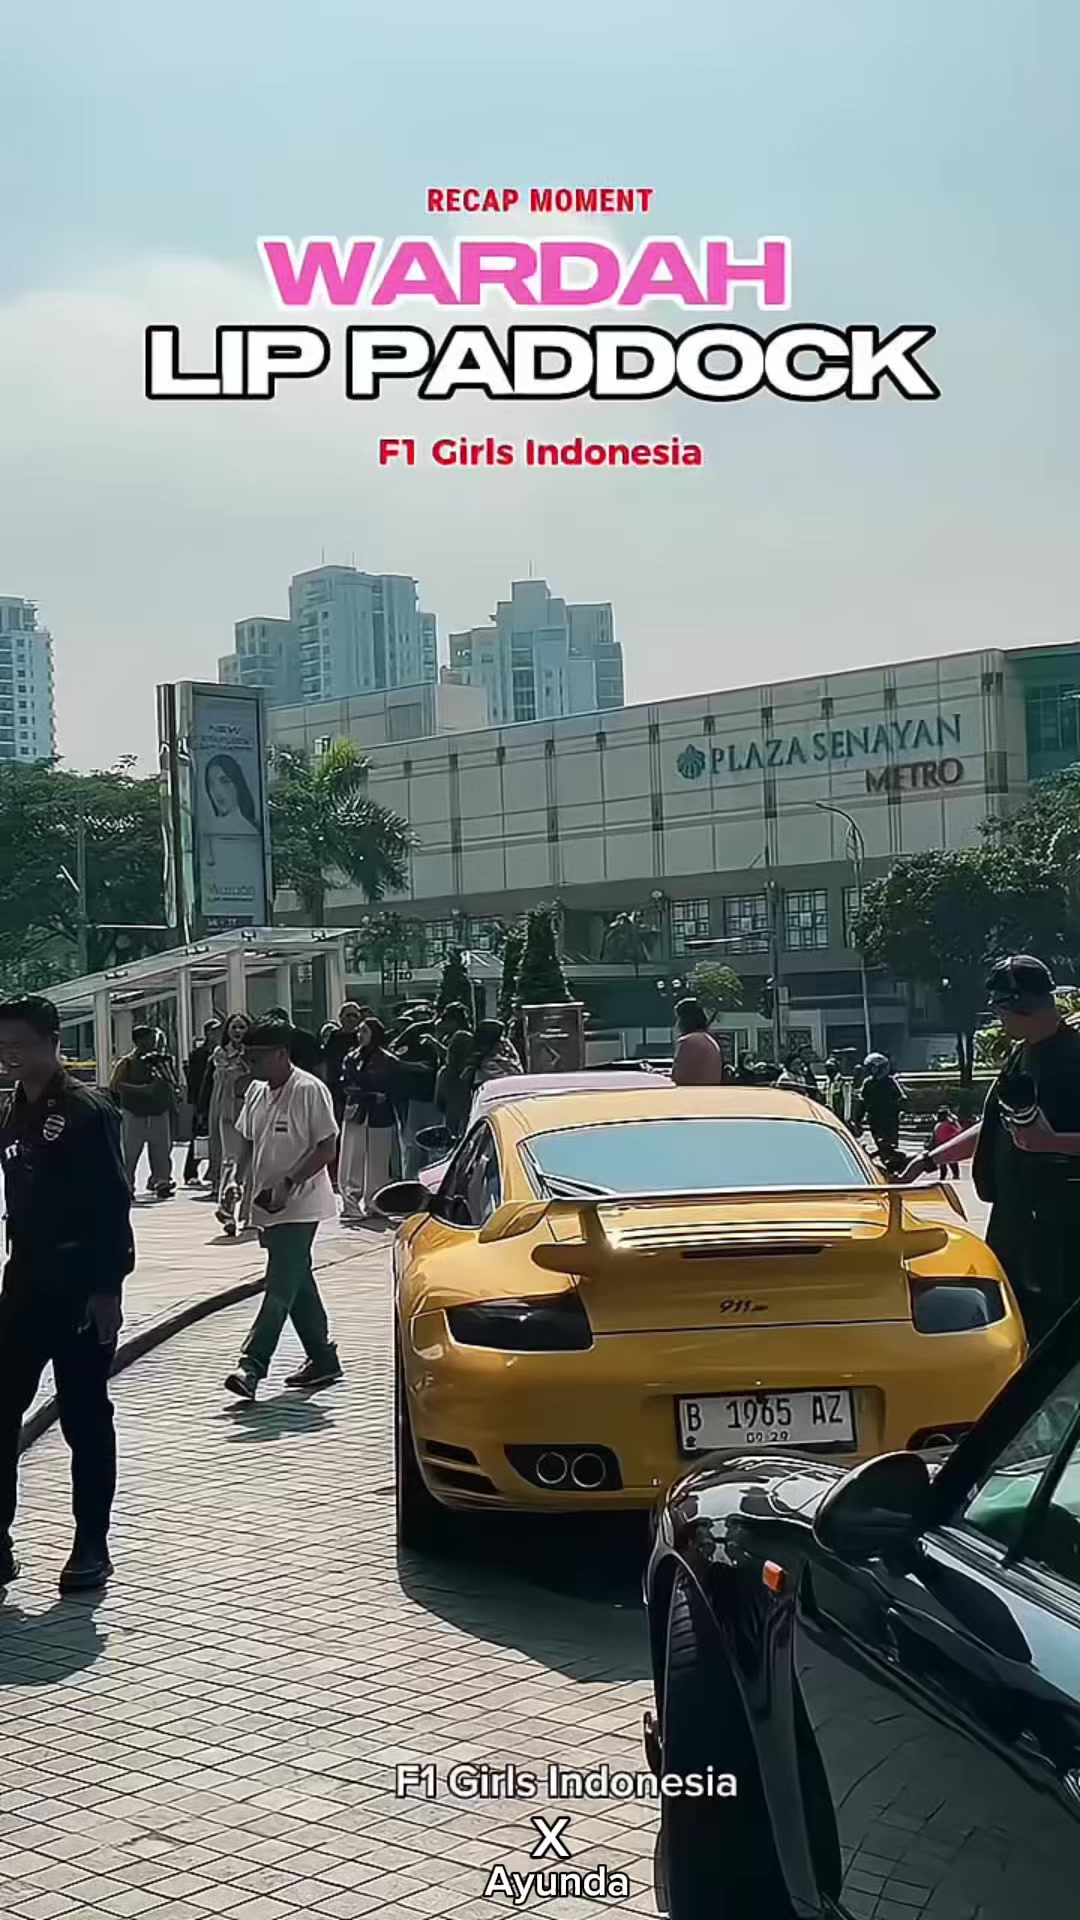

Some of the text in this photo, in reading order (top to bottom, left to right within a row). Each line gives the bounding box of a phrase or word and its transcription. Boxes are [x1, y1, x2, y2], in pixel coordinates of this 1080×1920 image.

[711, 713, 962, 774] PLAZA SENAYAN
[865, 757, 964, 794] METRO
[720, 1299, 752, 1314] 911
[686, 1394, 843, 1432] B 1965 AZ
